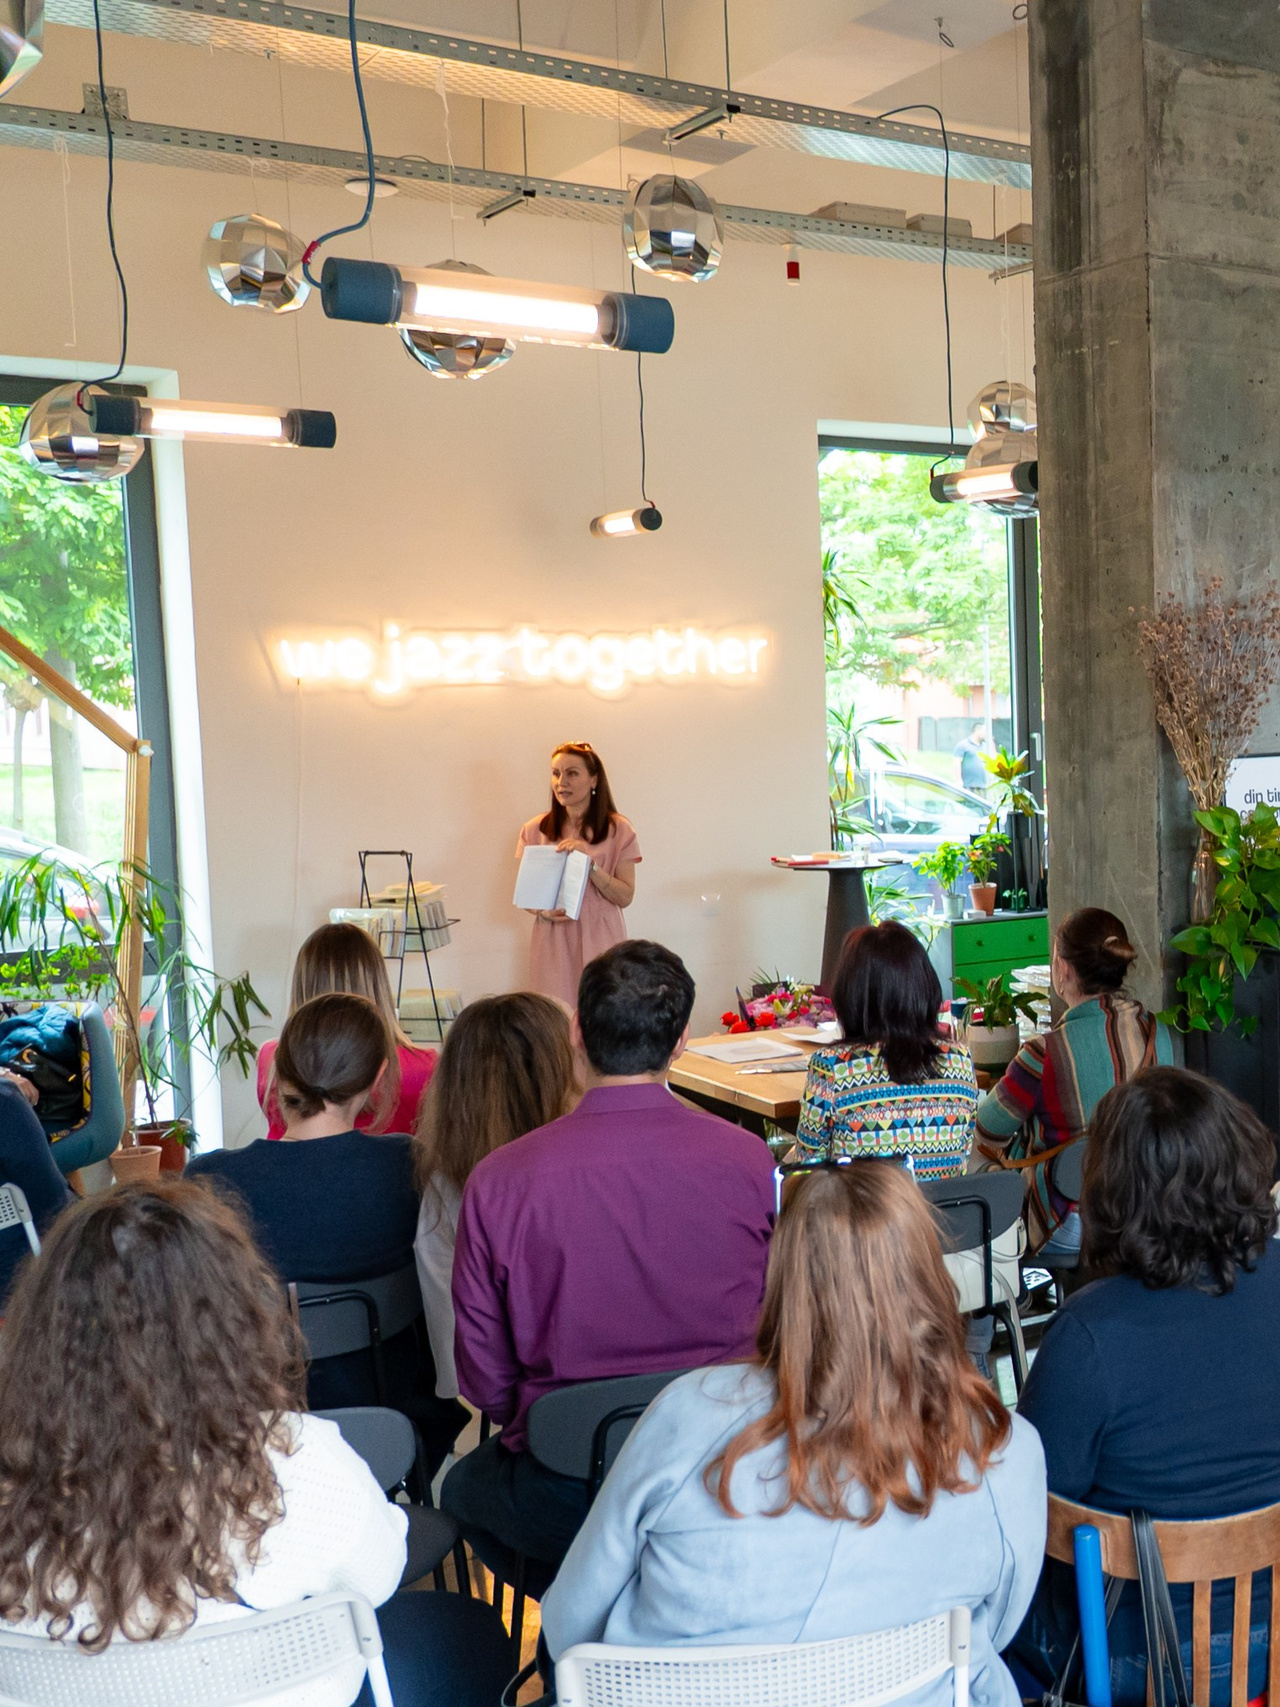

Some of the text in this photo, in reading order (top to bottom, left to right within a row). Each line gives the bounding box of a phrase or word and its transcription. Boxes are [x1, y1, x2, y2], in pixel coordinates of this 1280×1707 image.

[279, 623, 768, 695] we jazz together
[1244, 789, 1263, 804] din
